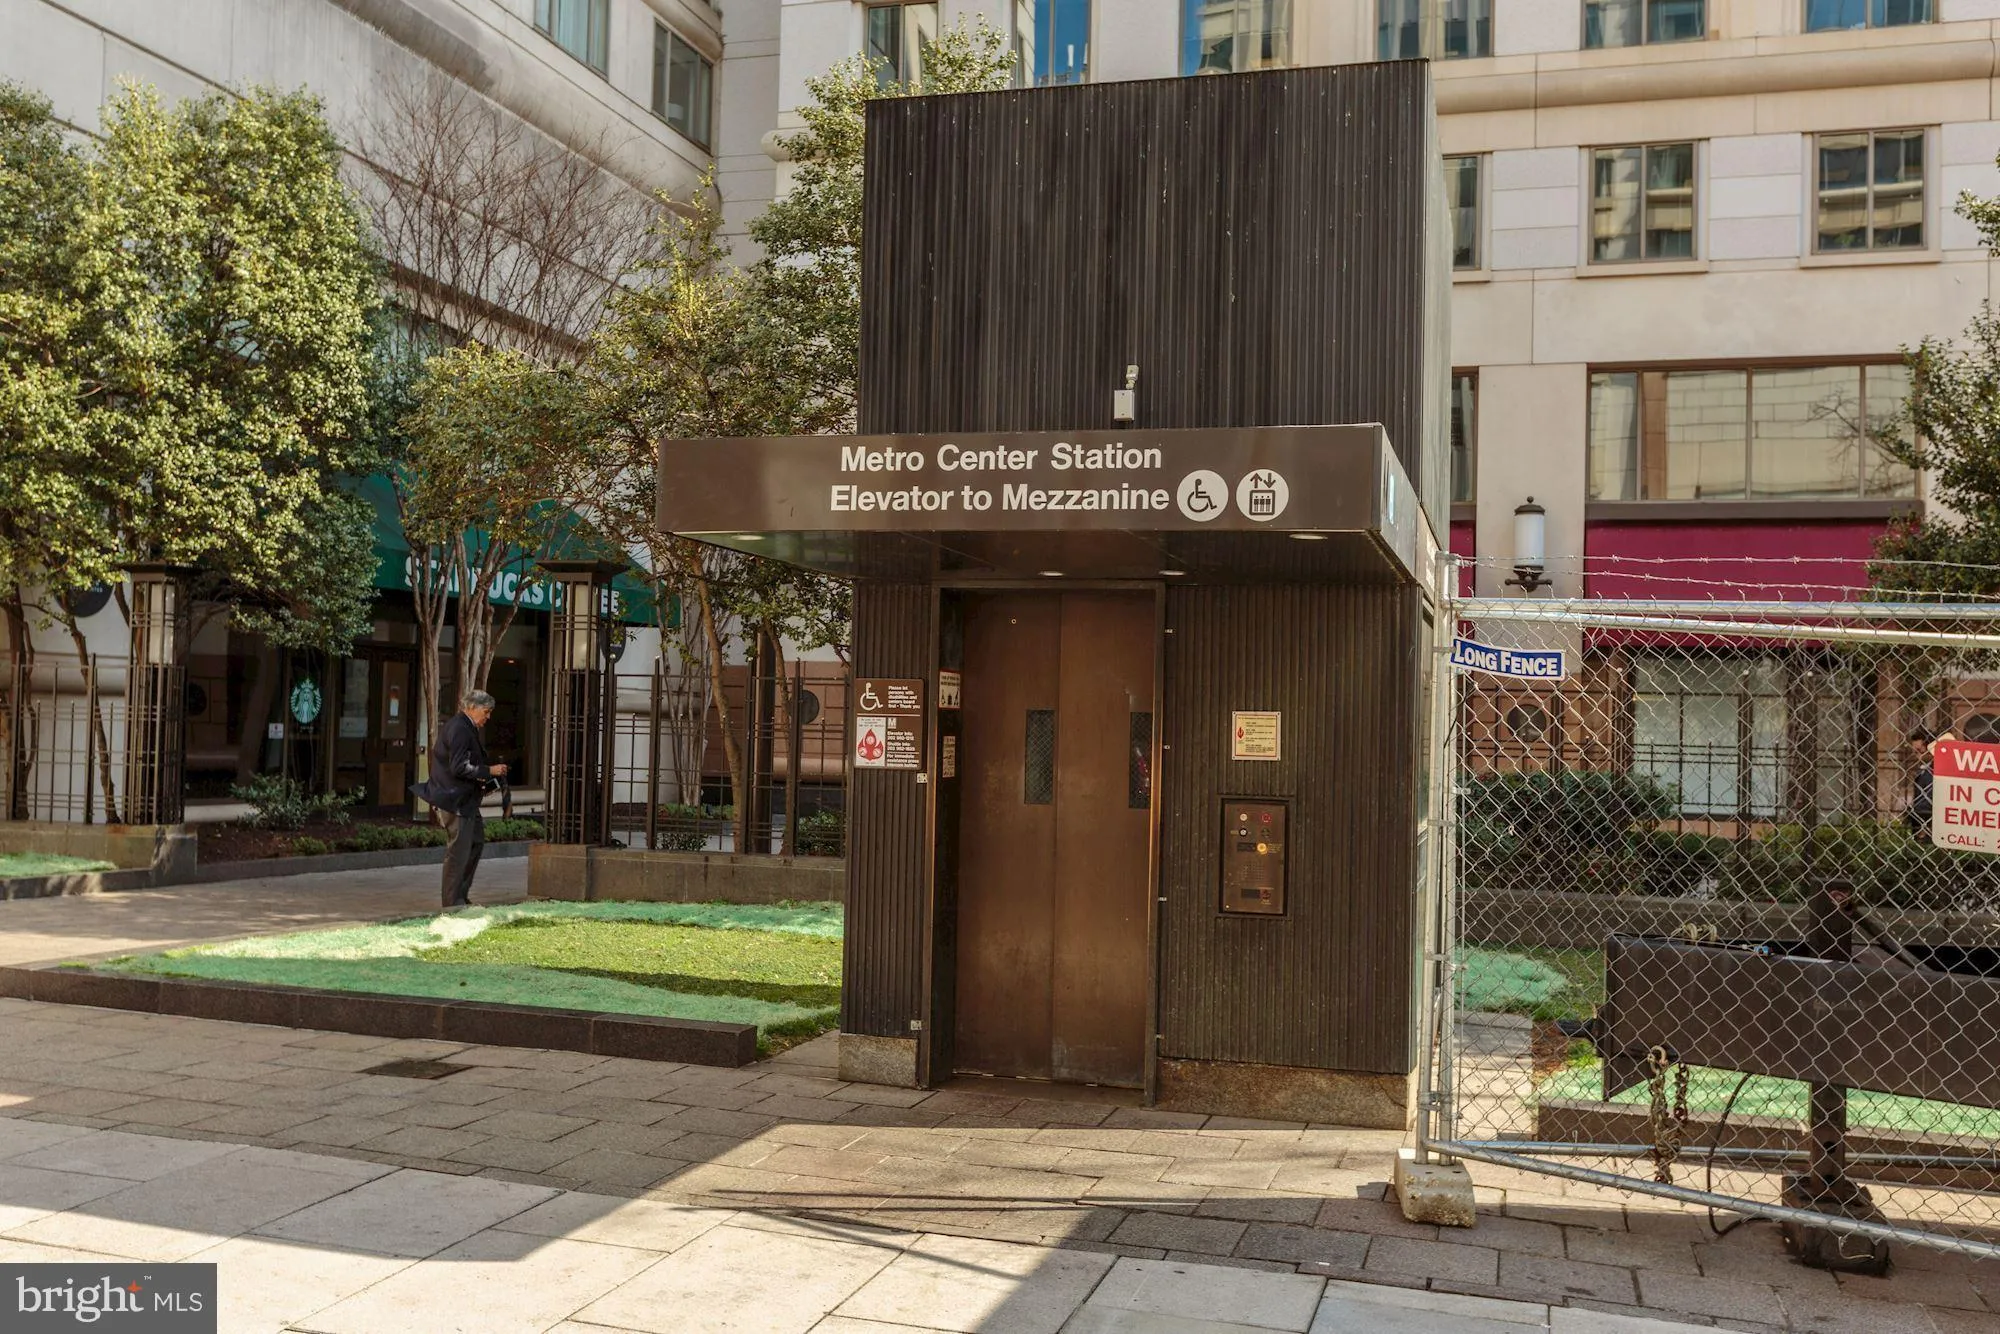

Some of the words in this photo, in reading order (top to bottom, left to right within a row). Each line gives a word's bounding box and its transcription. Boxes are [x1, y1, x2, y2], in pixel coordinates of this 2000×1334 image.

[841, 445, 925, 472] Metro
[937, 443, 1039, 471] Center
[1050, 442, 1162, 470] Station
[830, 484, 955, 512] Elevator
[961, 485, 993, 511] to
[1002, 482, 1170, 511] Mezzanine
[1454, 640, 1499, 671] LONG
[1500, 650, 1559, 676] FENCE
[1949, 784, 1972, 803] IN
[1944, 806, 2000, 830] EME
[1947, 833, 1985, 848] CALL:
